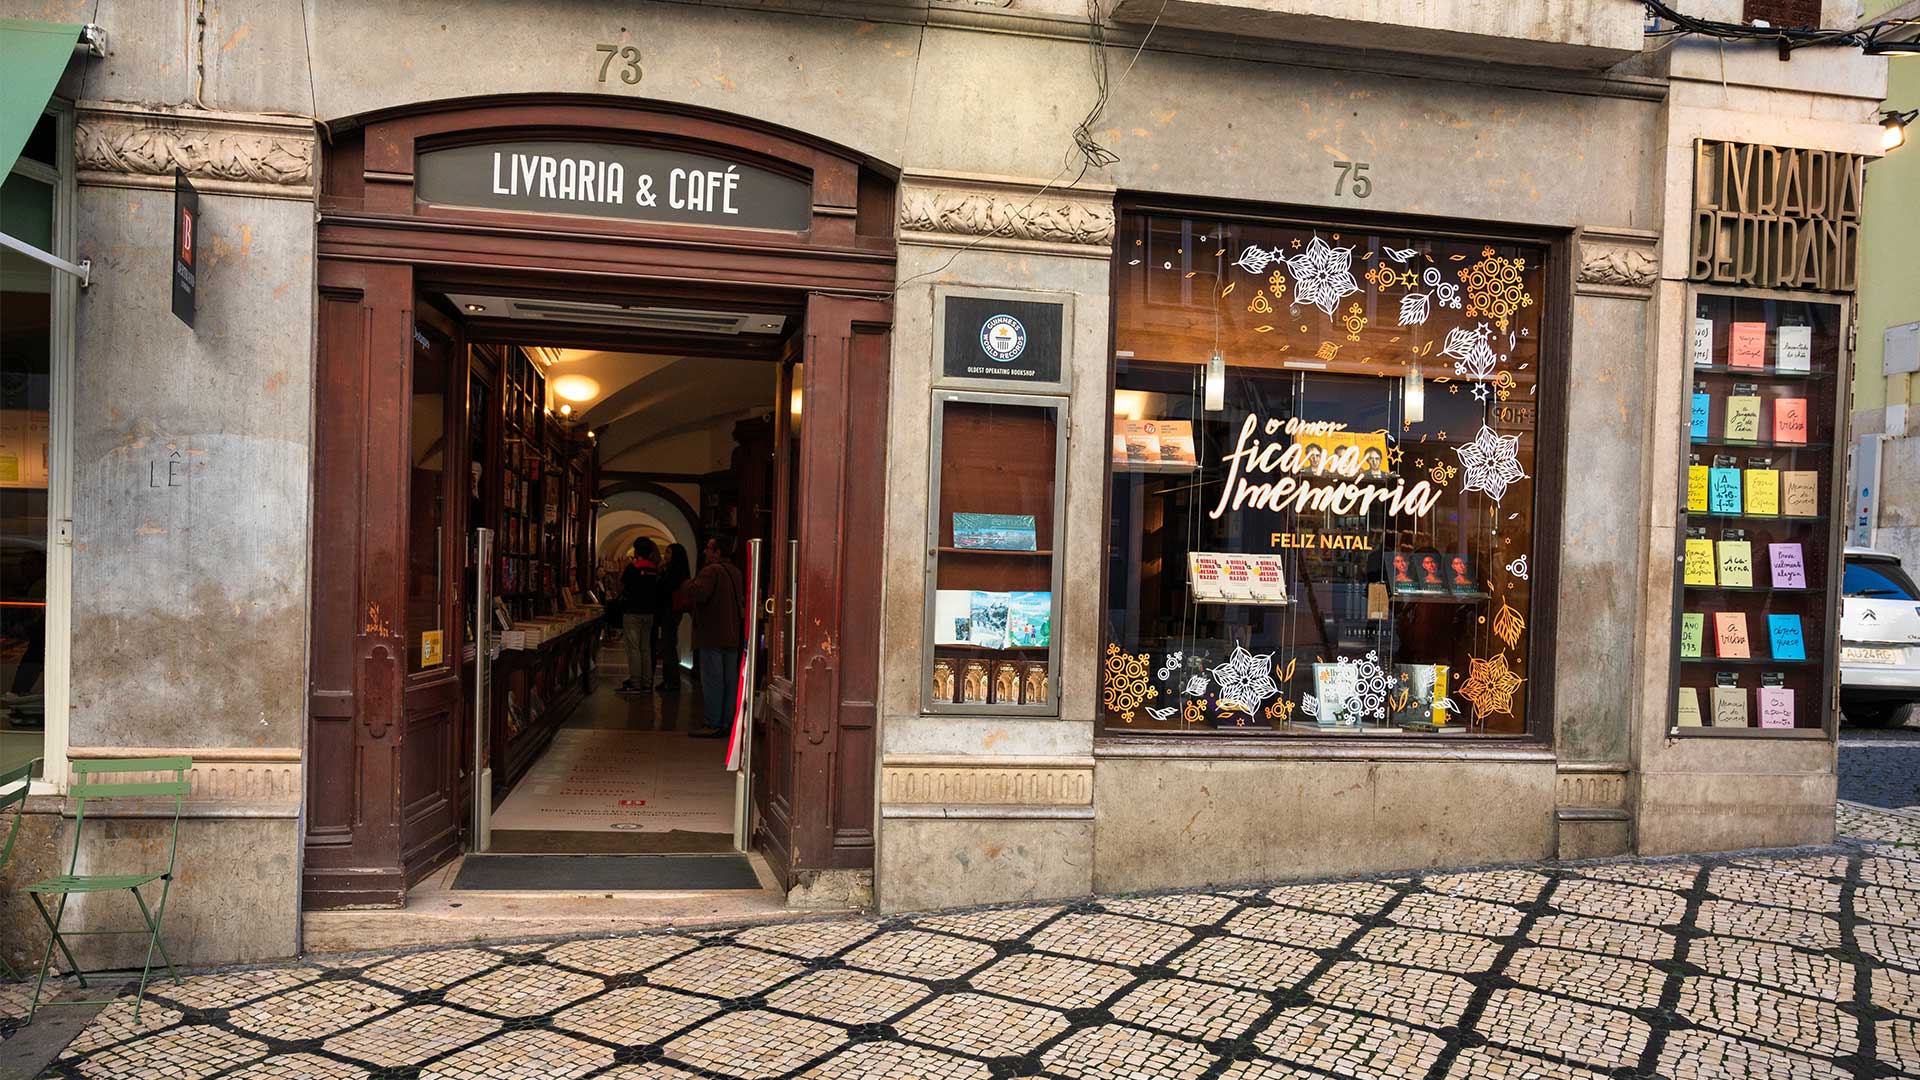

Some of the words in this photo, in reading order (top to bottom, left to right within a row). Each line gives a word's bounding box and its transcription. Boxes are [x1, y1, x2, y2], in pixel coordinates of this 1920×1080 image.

[596, 44, 643, 85] 73
[493, 152, 624, 204] LIVRARIA
[635, 174, 657, 207] &
[669, 165, 740, 214] CAFÉ
[1333, 161, 1372, 198] 75
[1693, 138, 1864, 224] LIVRARIA
[1690, 209, 1860, 291] BERTRAND
[987, 317, 1020, 331] GUINNESS
[983, 333, 999, 357] WORLD
[999, 335, 1024, 359] RECORDS
[968, 366, 985, 374] OLDEST
[985, 367, 1010, 376] OPERATING
[1011, 368, 1036, 377] BOOKSHOP
[1265, 417, 1285, 435] o
[1284, 416, 1348, 437] amor
[150, 451, 182, 487] LÊ
[1209, 413, 1313, 519] fica
[1316, 444, 1370, 477] na
[1231, 472, 1443, 518] memória
[1271, 533, 1316, 549] FELIZ
[1320, 535, 1373, 551] NATAL
